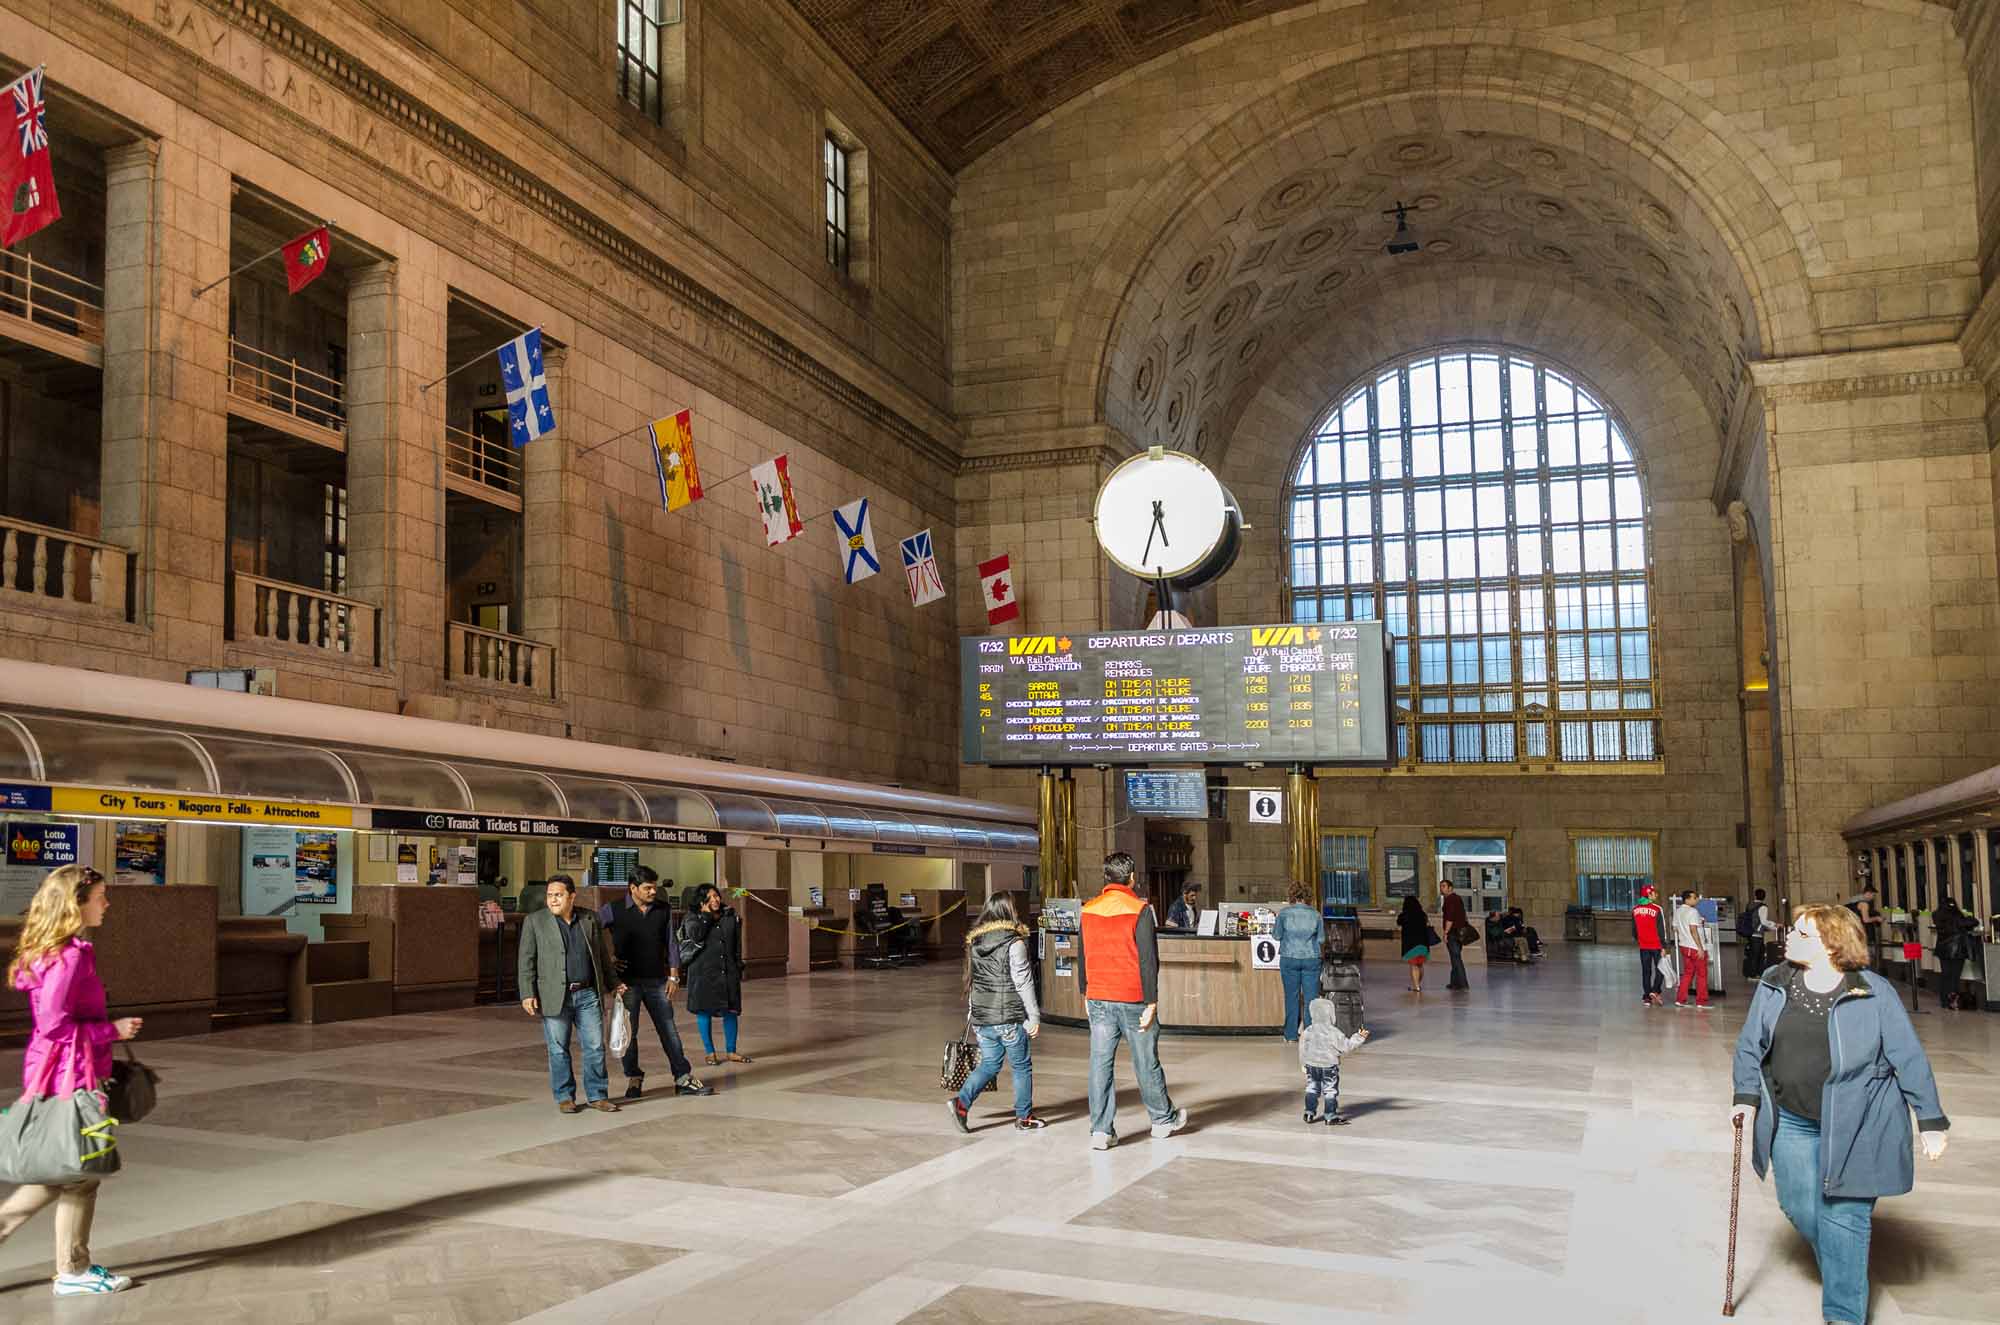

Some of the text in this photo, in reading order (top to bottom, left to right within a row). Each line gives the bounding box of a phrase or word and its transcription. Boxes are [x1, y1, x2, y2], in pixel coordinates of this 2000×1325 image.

[154, 0, 226, 57] BAY
[1088, 636, 1166, 649] DEPARTURES
[1177, 633, 1234, 645] DEPARTS
[1251, 626, 1304, 647] VIA
[1008, 636, 1056, 656] VIA
[1252, 645, 1323, 656] VIA Rail Canada
[1009, 654, 1073, 665] VIA Rail Canada
[1243, 656, 1265, 665] TIME
[1279, 655, 1324, 664] BOARDING
[979, 660, 1143, 673] TRAIN DESTINATION REMARKS
[1243, 662, 1355, 673] HEURE EMBARQUE PORT
[1104, 668, 1153, 678] REMARQUES
[1028, 681, 1059, 691] SARNIA
[1105, 680, 1118, 689] ON
[1155, 678, 1191, 687] L'HEURE
[1028, 691, 1060, 700] OTTAWA
[1105, 689, 1118, 698] ON
[1155, 687, 1191, 696] L'HEURE
[1028, 706, 1064, 716] WINDSOR
[1105, 706, 1118, 715] ON
[1156, 704, 1192, 714] L'HEURE
[1028, 724, 1075, 733] VANCOUVER
[1106, 723, 1118, 732] ON
[1156, 722, 1193, 731] L'HEURE
[1128, 742, 1209, 752] DEPARTURE GATES
[99, 794, 321, 819] City Tours Niagara Falls Attractions
[447, 816, 480, 830] Transit
[486, 819, 518, 832] Tickets
[533, 821, 560, 834] Billets
[44, 830, 66, 839] Lotto
[625, 828, 650, 839] Transit
[653, 829, 677, 841] Tickets
[687, 832, 707, 843] Billets
[44, 840, 71, 850] Centre
[44, 851, 74, 861] de Loto
